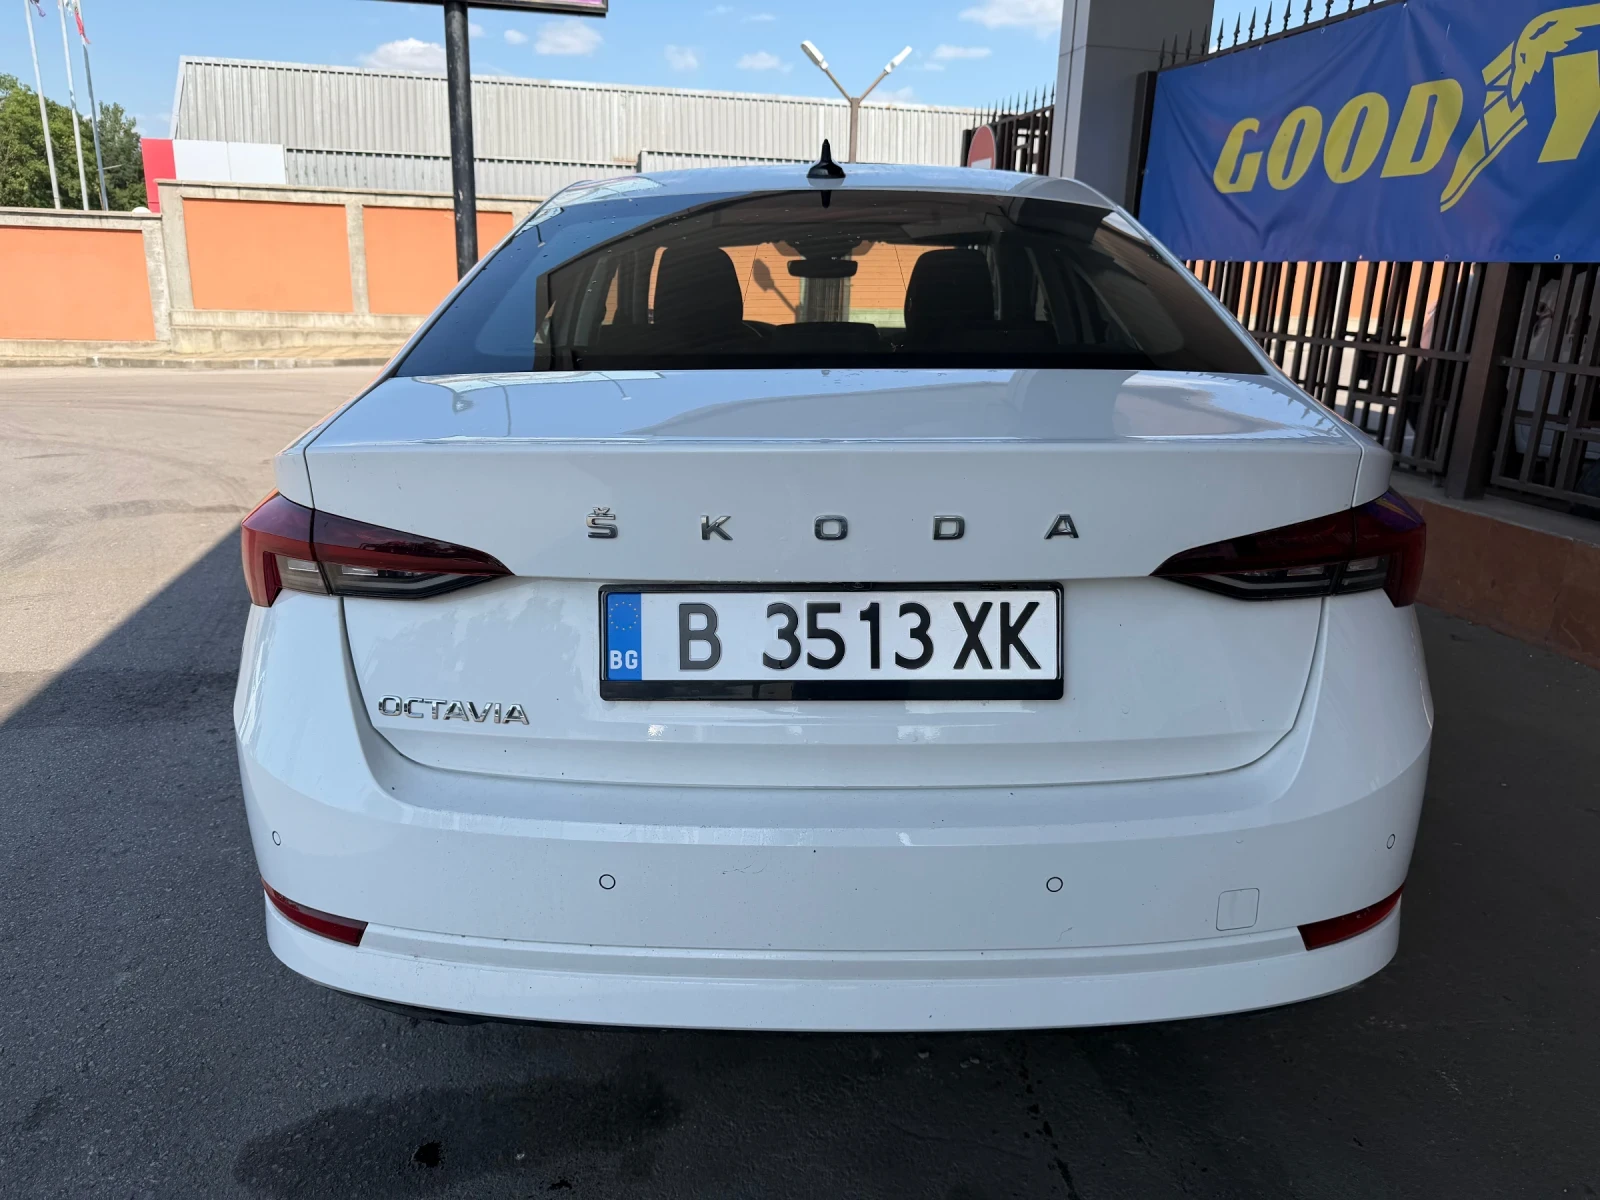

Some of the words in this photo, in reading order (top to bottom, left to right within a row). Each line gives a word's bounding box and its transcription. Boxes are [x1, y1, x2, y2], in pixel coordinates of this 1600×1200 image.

[586, 507, 1080, 541] ŠKODA
[678, 602, 722, 671] B
[762, 602, 934, 670] 3513
[952, 601, 1042, 670] XK
[609, 650, 639, 671] BG
[378, 695, 530, 725] OCTAVIA
